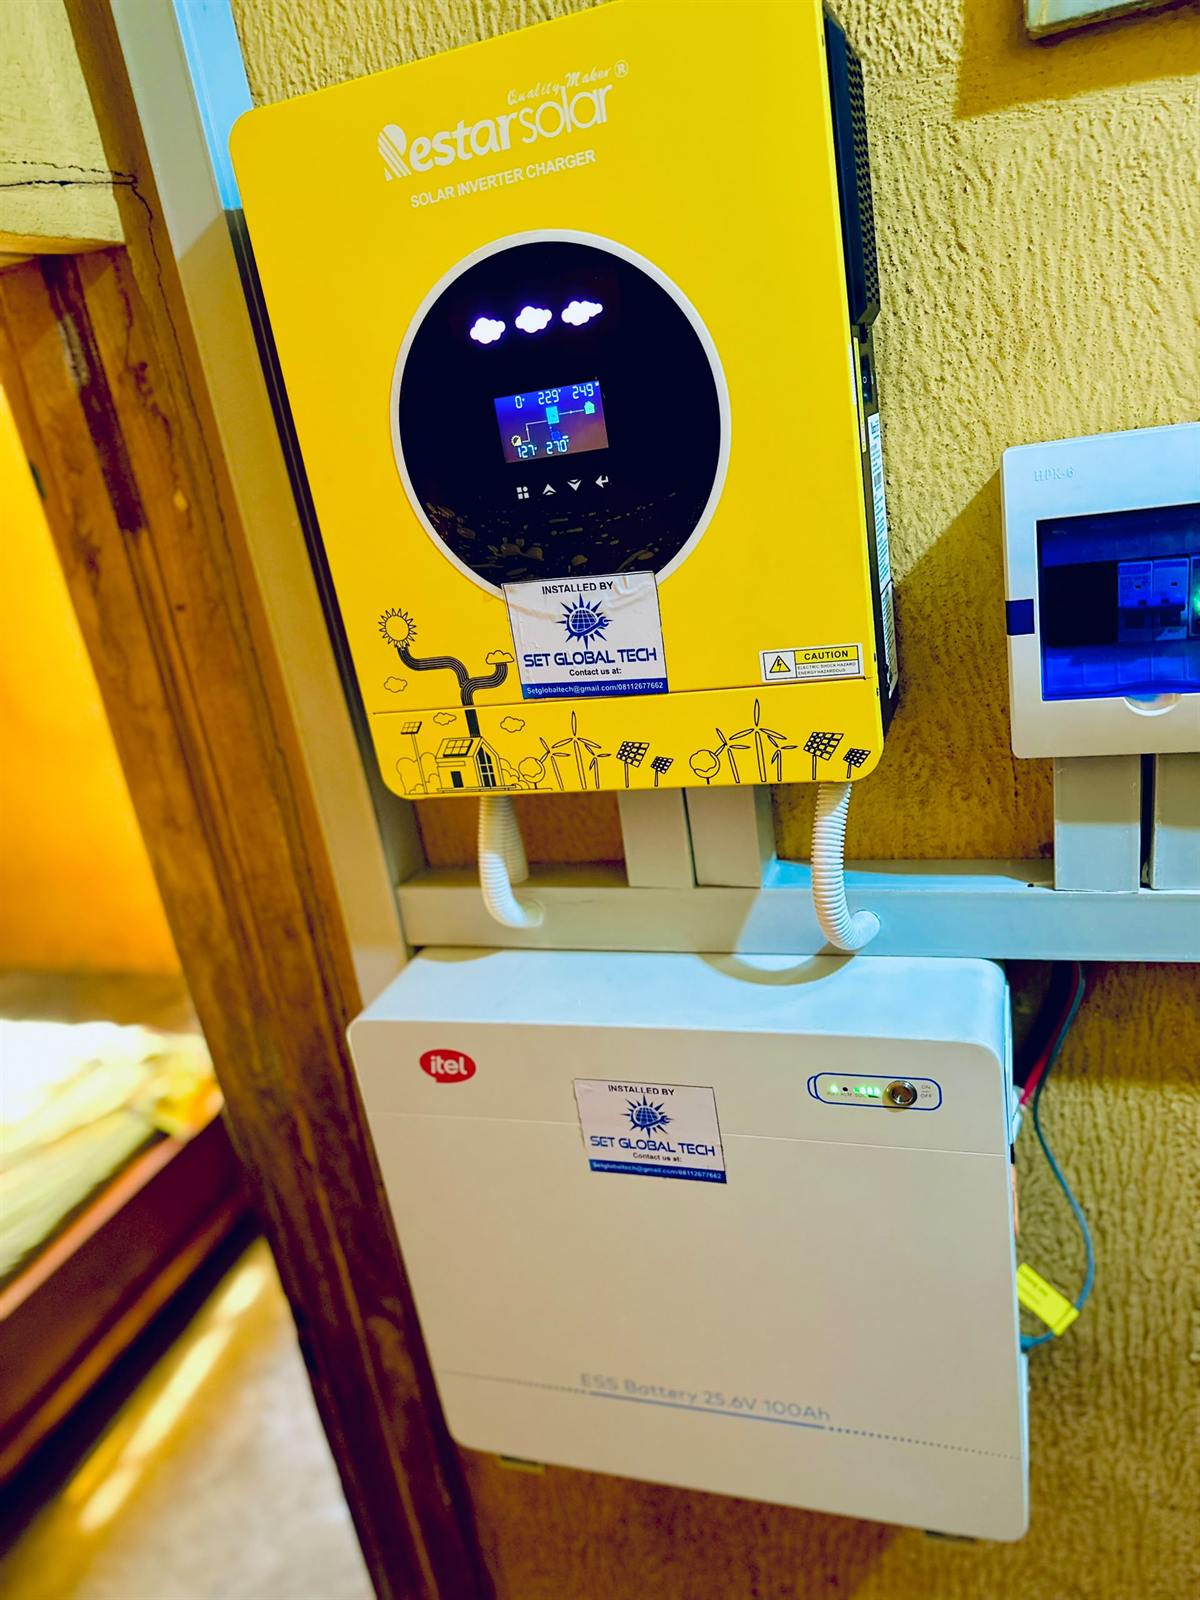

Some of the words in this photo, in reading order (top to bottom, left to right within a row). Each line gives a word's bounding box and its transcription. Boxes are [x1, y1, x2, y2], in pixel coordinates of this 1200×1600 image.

[507, 82, 561, 106] Quality
[410, 185, 455, 208] SOLAR
[456, 167, 524, 197] INVERTER
[525, 149, 596, 179] CHARGER
[572, 383, 595, 400] 249
[542, 582, 597, 595] INSTALLED
[600, 581, 614, 591] BY
[523, 653, 551, 667] SET
[554, 650, 616, 667] GLOBAL
[617, 647, 657, 663] TECH
[804, 650, 849, 661] CAUTION
[569, 667, 599, 677] Contact
[612, 667, 622, 675] at:
[430, 1055, 468, 1075] itel
[608, 1084, 660, 1095] INSTALLED
[661, 1088, 675, 1096] BY
[590, 1135, 615, 1148] SET
[618, 1138, 676, 1153] GLOBAL
[677, 1142, 716, 1157] TECH
[632, 1152, 661, 1161] Contact
[673, 1155, 683, 1163] at:
[580, 1372, 618, 1391] ESS
[624, 1379, 698, 1404] Battery
[703, 1390, 757, 1411] 25.6V
[763, 1400, 831, 1422] 100Ah
